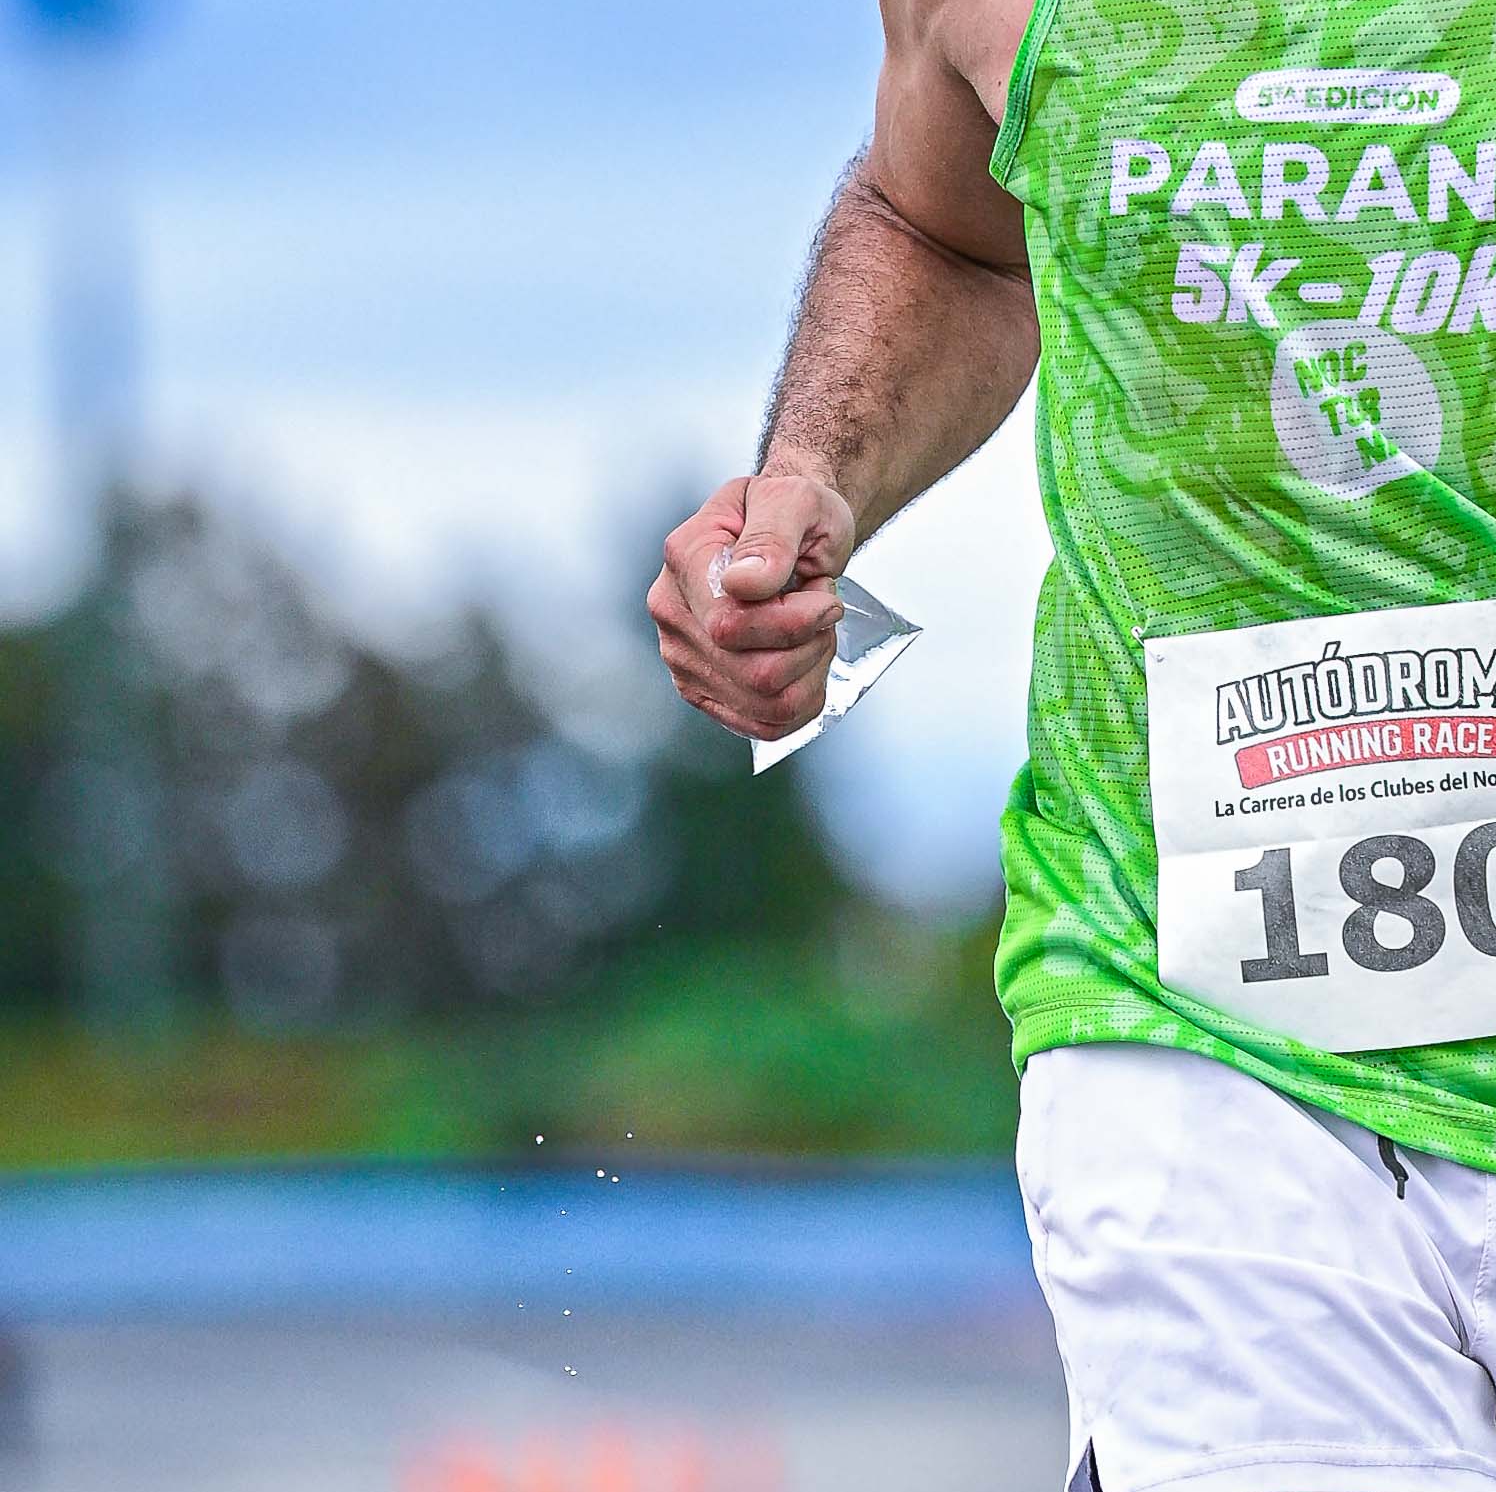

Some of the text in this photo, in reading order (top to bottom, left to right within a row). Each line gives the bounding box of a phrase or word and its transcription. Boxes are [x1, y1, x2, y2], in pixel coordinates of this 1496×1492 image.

[1304, 84, 1440, 112] EDICIÓN
[1266, 722, 1494, 779] RUNNING RACE
[1214, 799, 1235, 818] La
[1239, 788, 1306, 815] Carrera
[1310, 786, 1335, 807] de
[1339, 783, 1367, 803] los
[1371, 776, 1436, 799] Clubes
[1439, 770, 1469, 791] del
